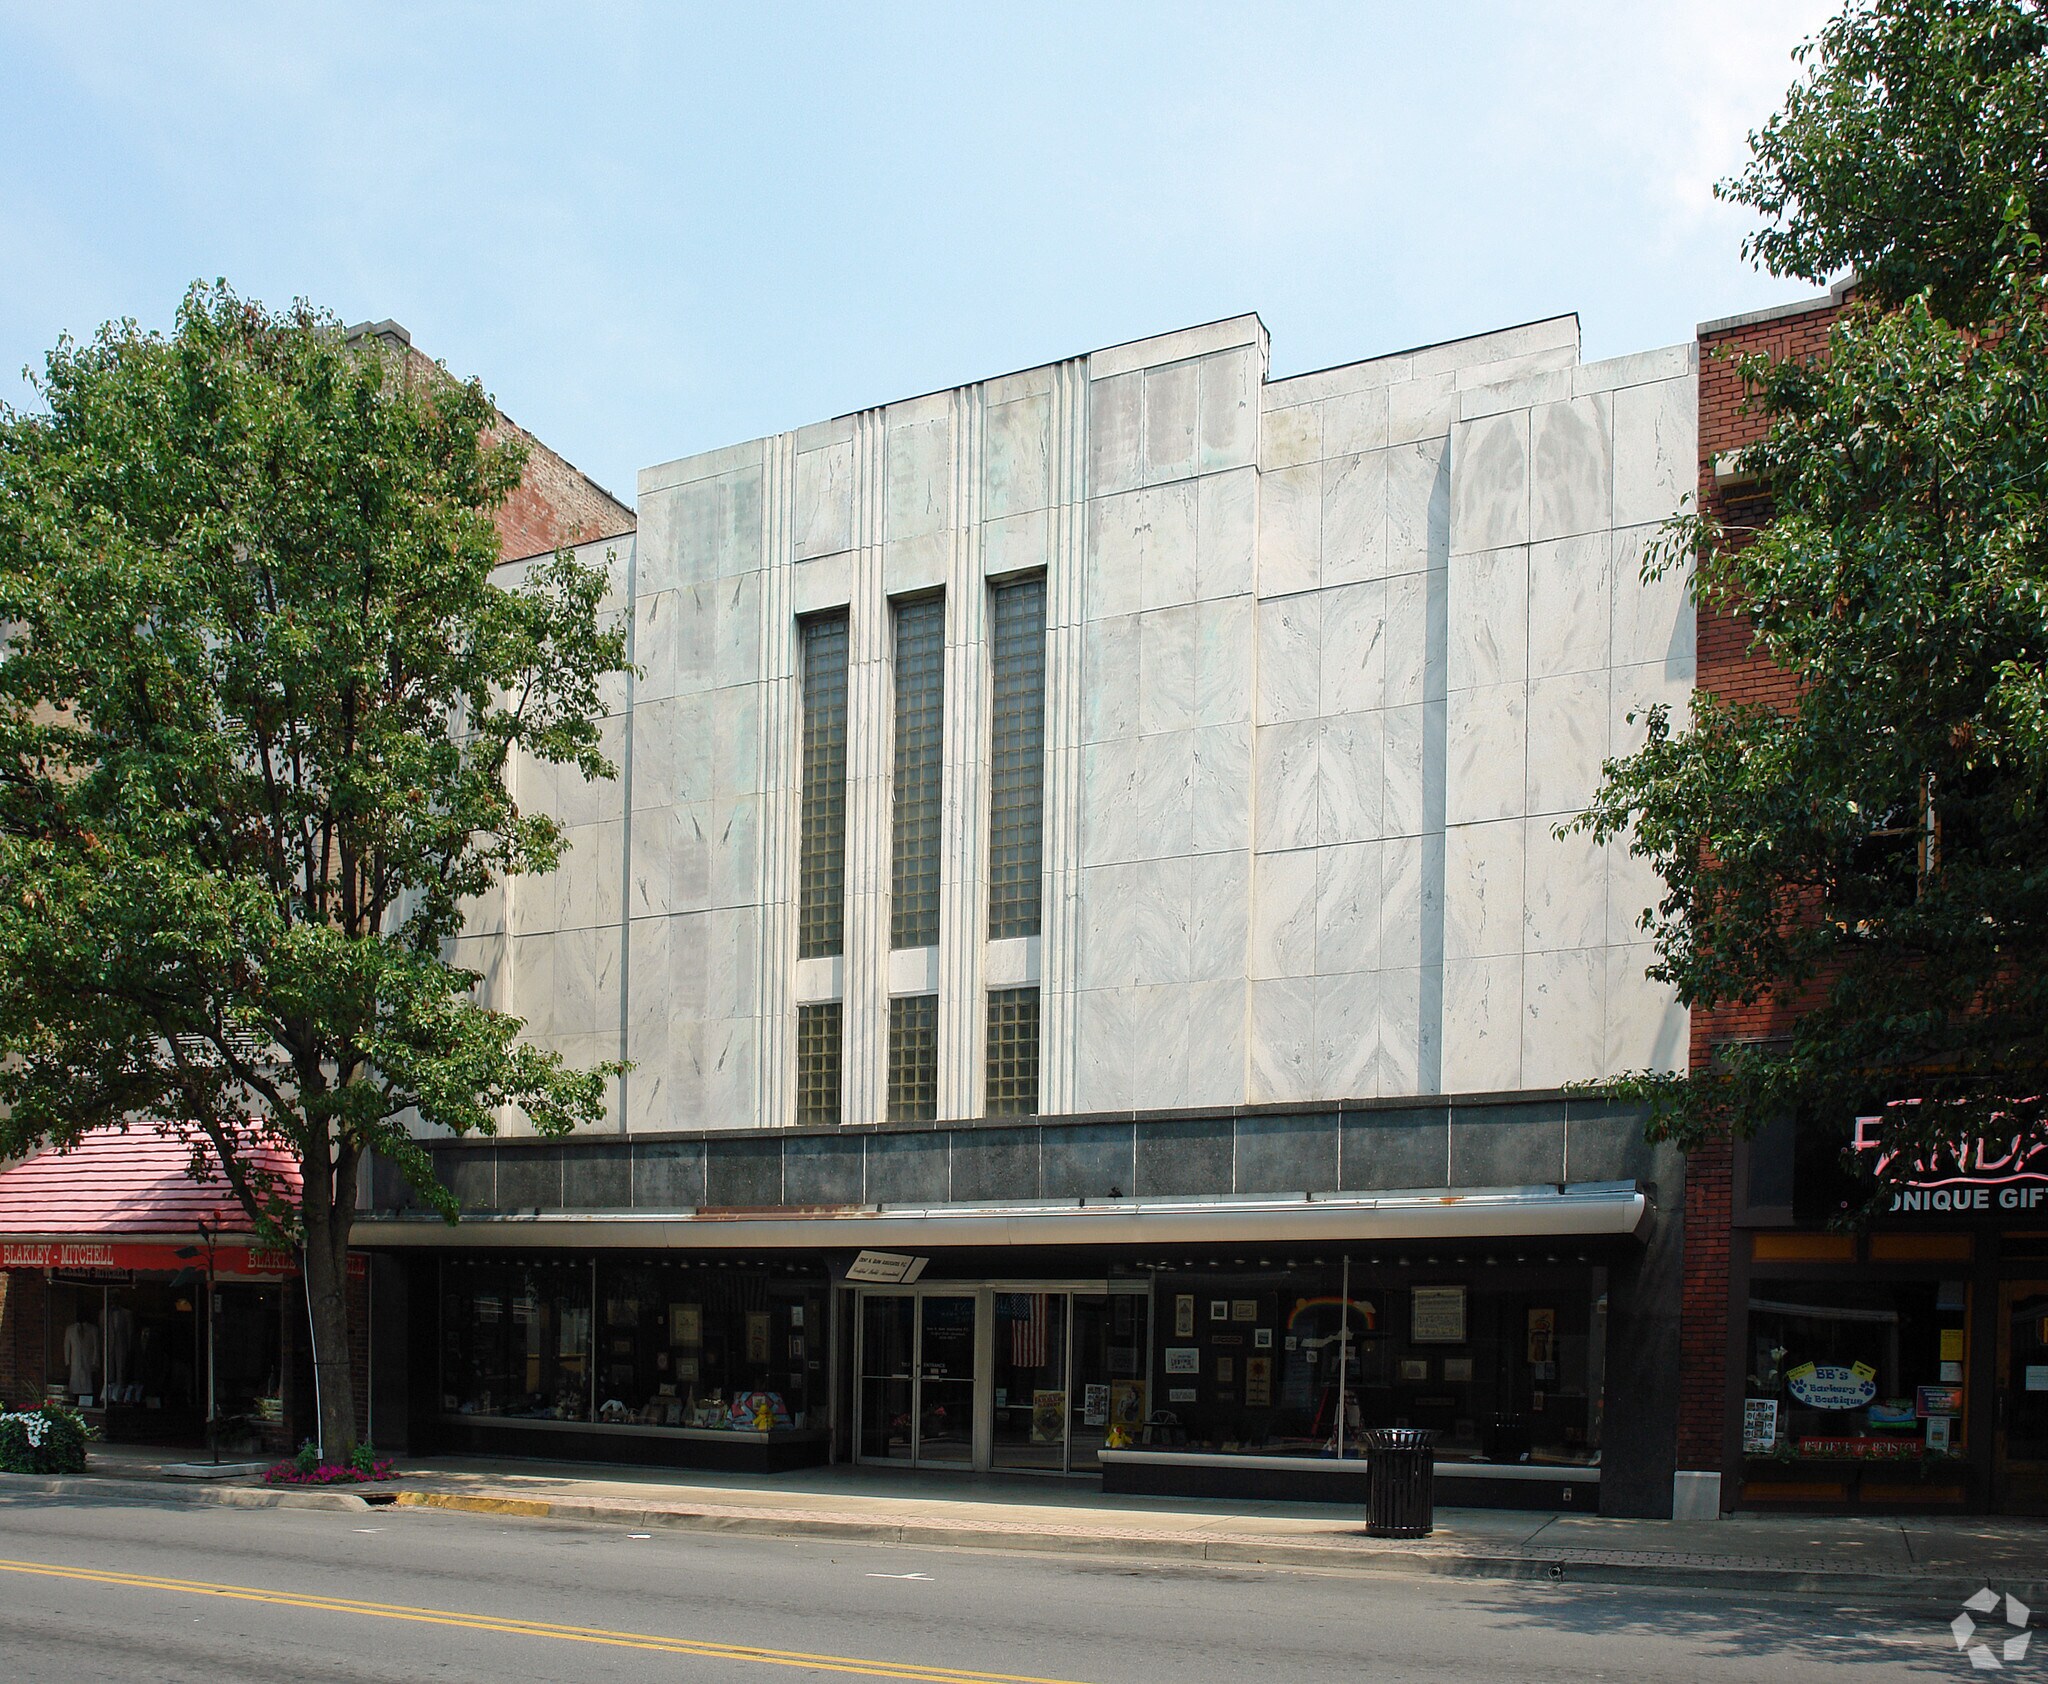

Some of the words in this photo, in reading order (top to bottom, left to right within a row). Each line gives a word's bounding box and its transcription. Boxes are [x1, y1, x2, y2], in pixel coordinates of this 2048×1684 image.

[1998, 1187, 2048, 1209] GIF
[3, 1245, 51, 1265] BLAKLEY
[60, 1245, 114, 1265] MITCHELL
[248, 1250, 297, 1269] BLAKLE
[1814, 1395, 1864, 1406] Boutique
